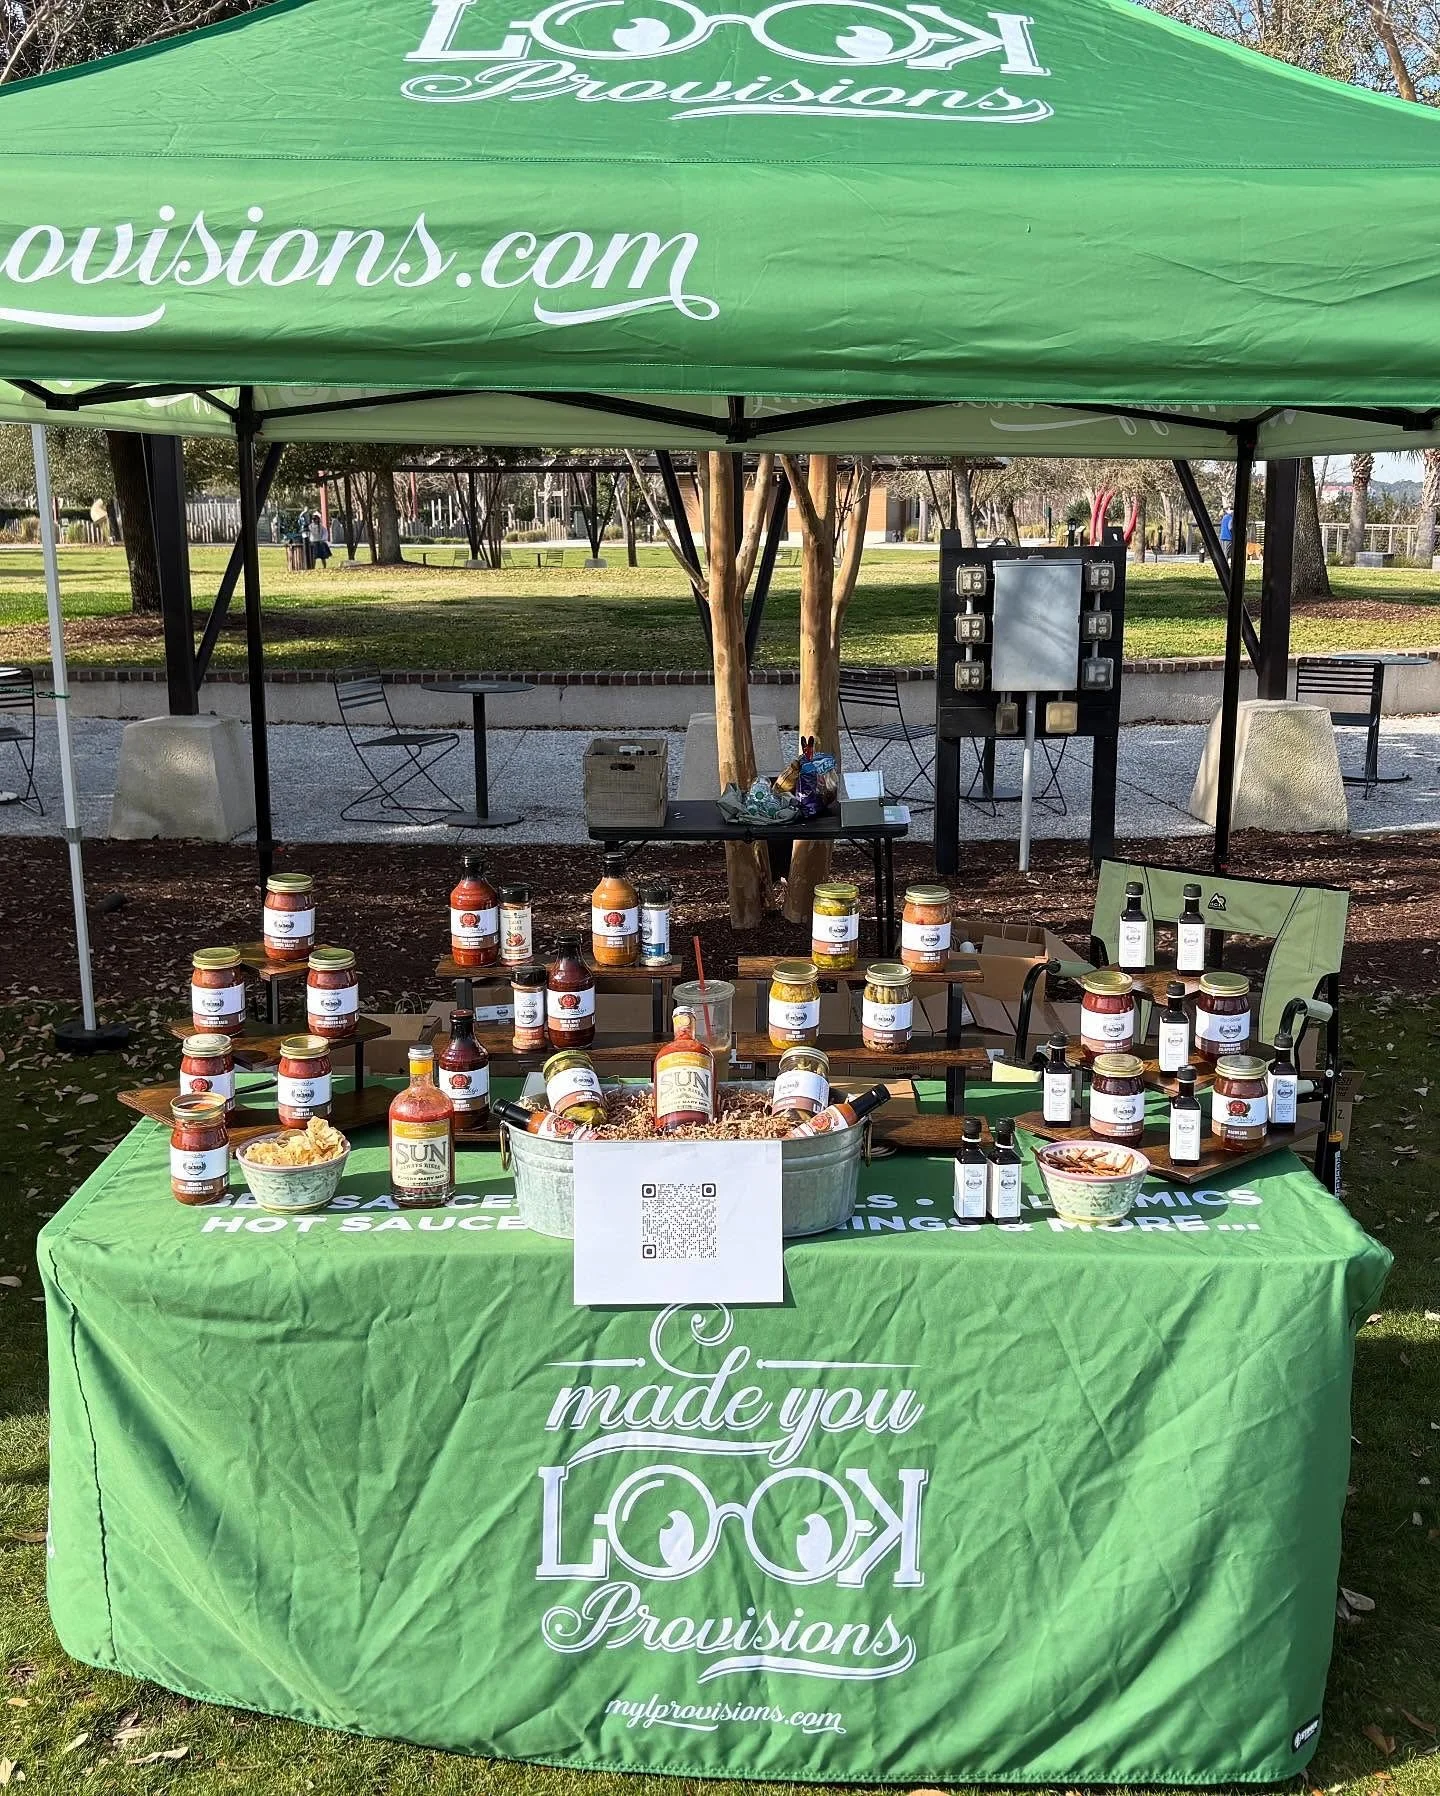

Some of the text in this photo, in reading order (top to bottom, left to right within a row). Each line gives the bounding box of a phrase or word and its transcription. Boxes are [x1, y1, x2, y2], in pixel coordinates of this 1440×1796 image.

[400, 59, 1054, 123] Provisions
[661, 1071, 710, 1098] SUN
[396, 1141, 447, 1168] SUN
[201, 1216, 329, 1233] HOT
[545, 1303, 926, 1468] made you
[535, 1464, 929, 1588] LOOK
[541, 1581, 917, 1684] Provisions
[604, 1693, 847, 1734] mylprovisions.com
